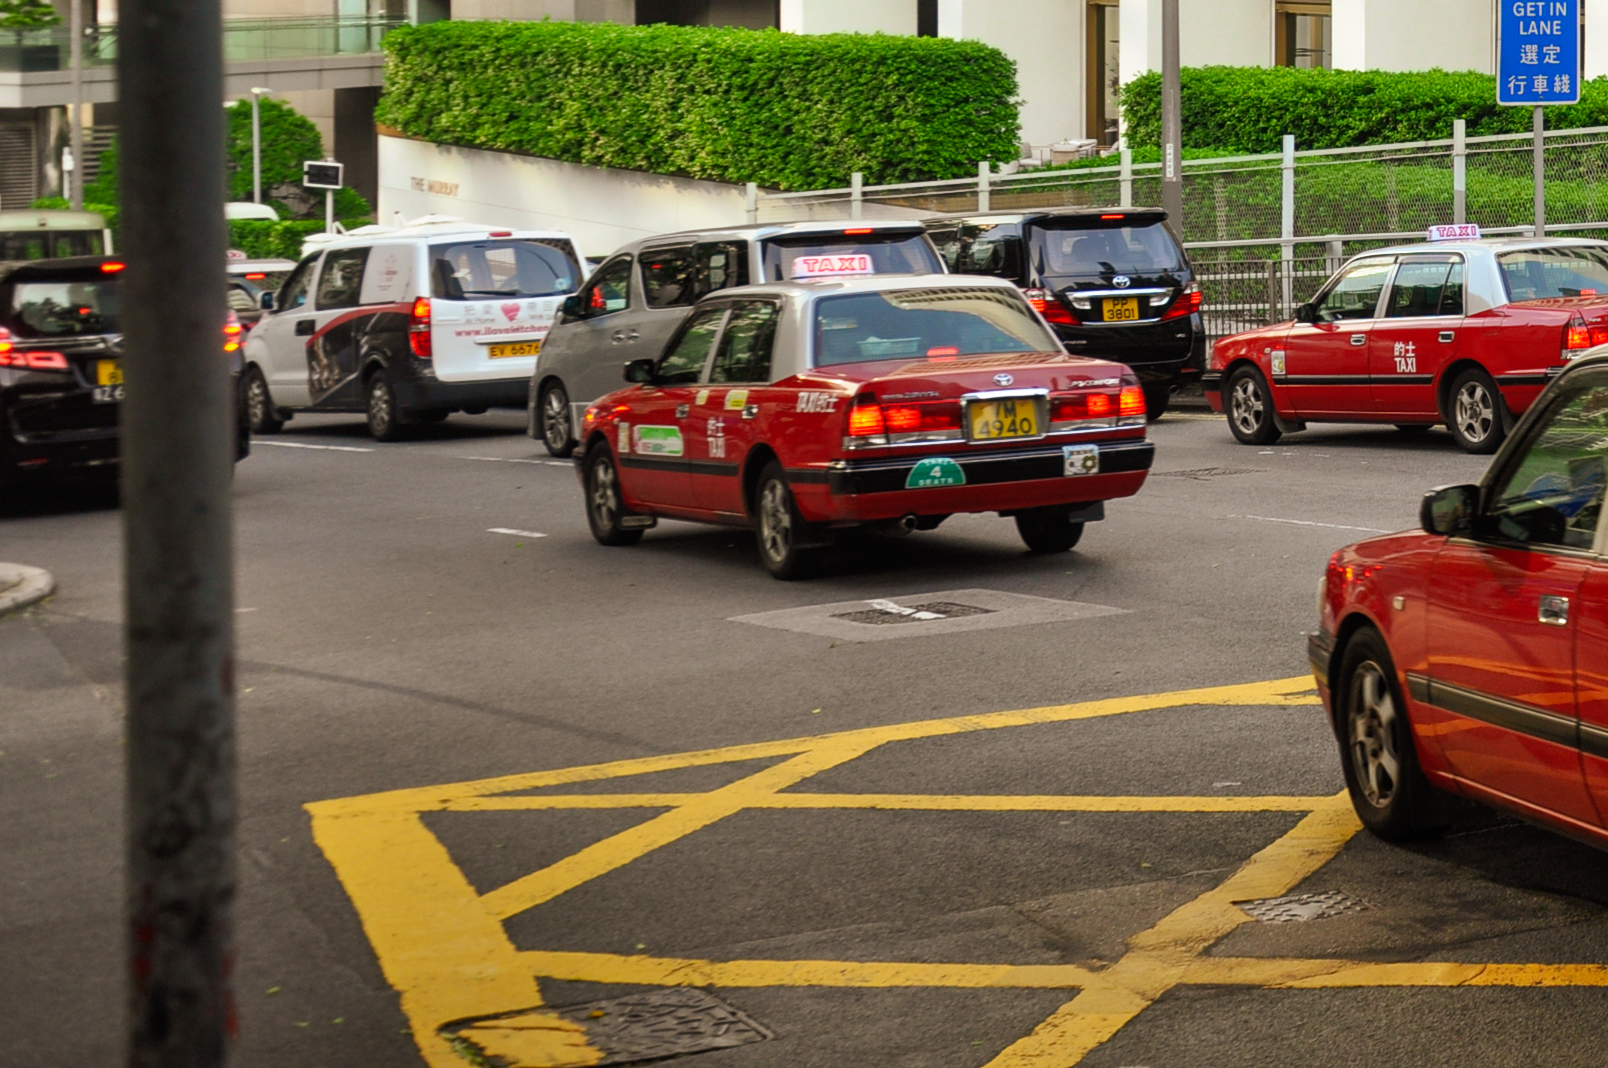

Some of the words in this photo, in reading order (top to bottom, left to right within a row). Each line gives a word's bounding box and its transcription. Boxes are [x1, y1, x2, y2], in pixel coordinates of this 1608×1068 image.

[1513, 2, 1545, 17] GET
[1550, 2, 1567, 17] IN
[1519, 21, 1562, 35] LANE
[1520, 44, 1561, 65] 選定
[410, 176, 425, 192] THE
[1436, 225, 1477, 237] TAXI
[803, 257, 867, 272] TAXI
[1112, 298, 1129, 309] PP
[1107, 309, 1135, 320] 3801
[1394, 341, 1416, 357] 的士
[1394, 357, 1417, 373] TAXI
[979, 417, 1032, 438] 4940
[707, 436, 726, 458] TAXI
[929, 466, 942, 477] 4
[918, 478, 954, 486] SEATS
